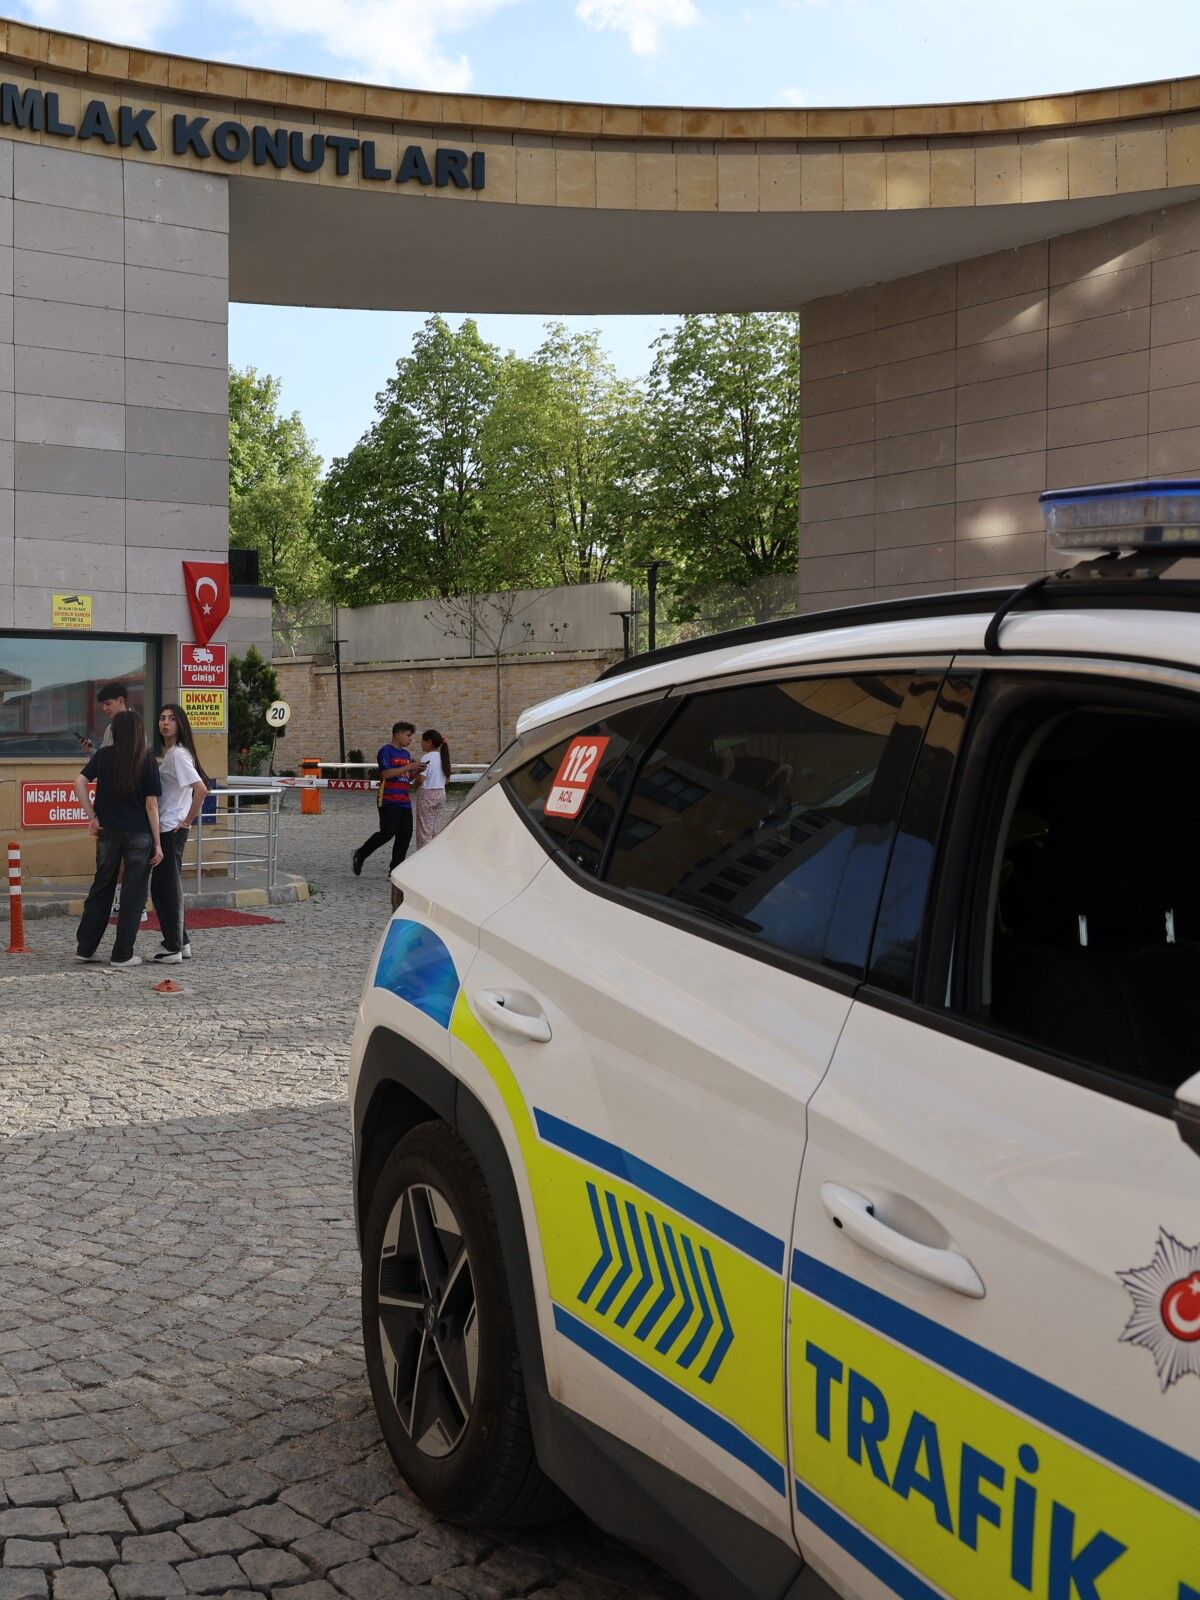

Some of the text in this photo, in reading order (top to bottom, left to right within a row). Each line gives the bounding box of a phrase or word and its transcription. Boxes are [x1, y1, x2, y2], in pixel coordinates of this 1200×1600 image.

[173, 113, 486, 190] KONUTLARI
[182, 663, 224, 673] TEDARİKÇİ
[191, 673, 216, 683] GİRİŞİ
[185, 691, 217, 703] DİKKAT
[186, 703, 220, 711] BARİYER
[271, 707, 285, 720] 20
[561, 745, 598, 783] 112
[330, 780, 370, 790] YAVAŞ
[26, 788, 67, 803] MİSAFİR
[49, 806, 90, 820] GİREME
[805, 1340, 1128, 1600] TRAFİK
